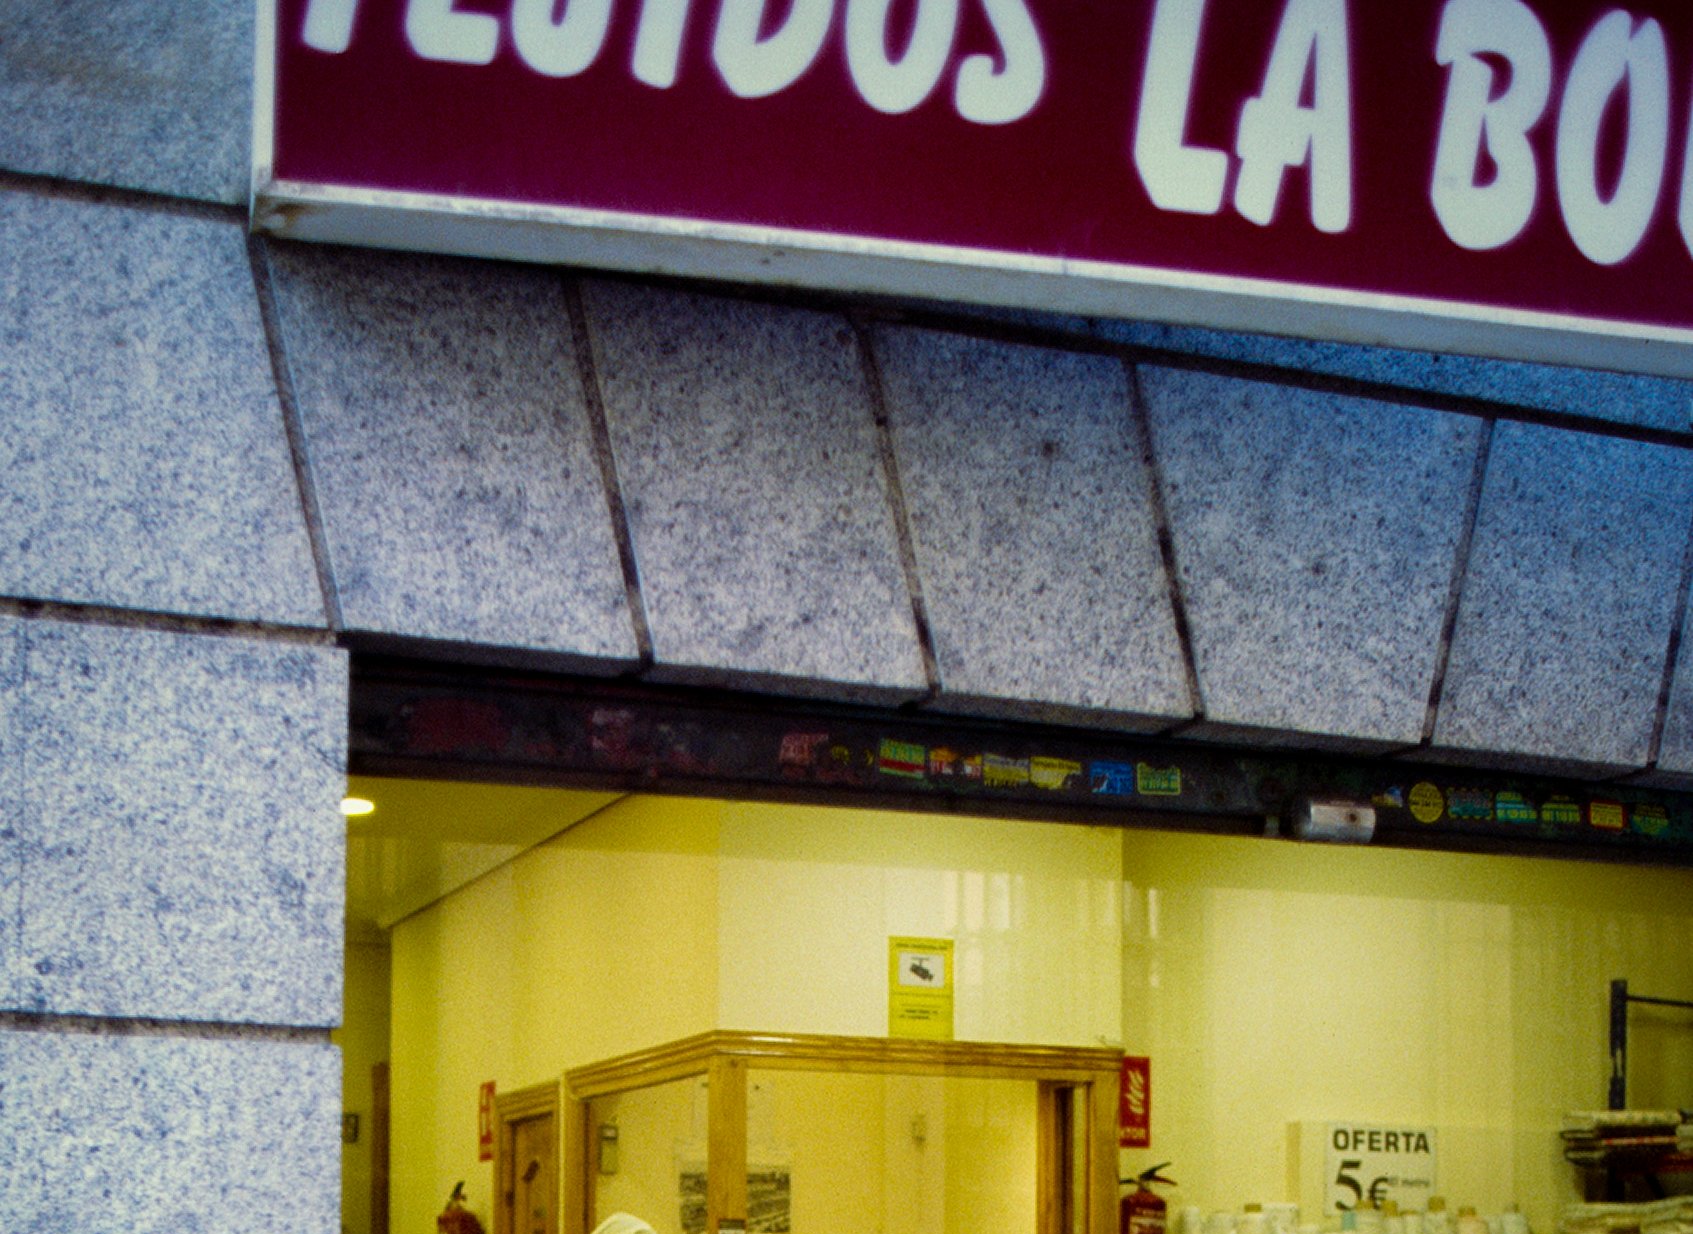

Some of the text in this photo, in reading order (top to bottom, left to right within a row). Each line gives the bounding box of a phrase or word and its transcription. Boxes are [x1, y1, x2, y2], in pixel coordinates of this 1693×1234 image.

[1133, 0, 1353, 234] LA
[1430, 0, 1693, 266] BO
[1332, 1128, 1430, 1154] OFERTA
